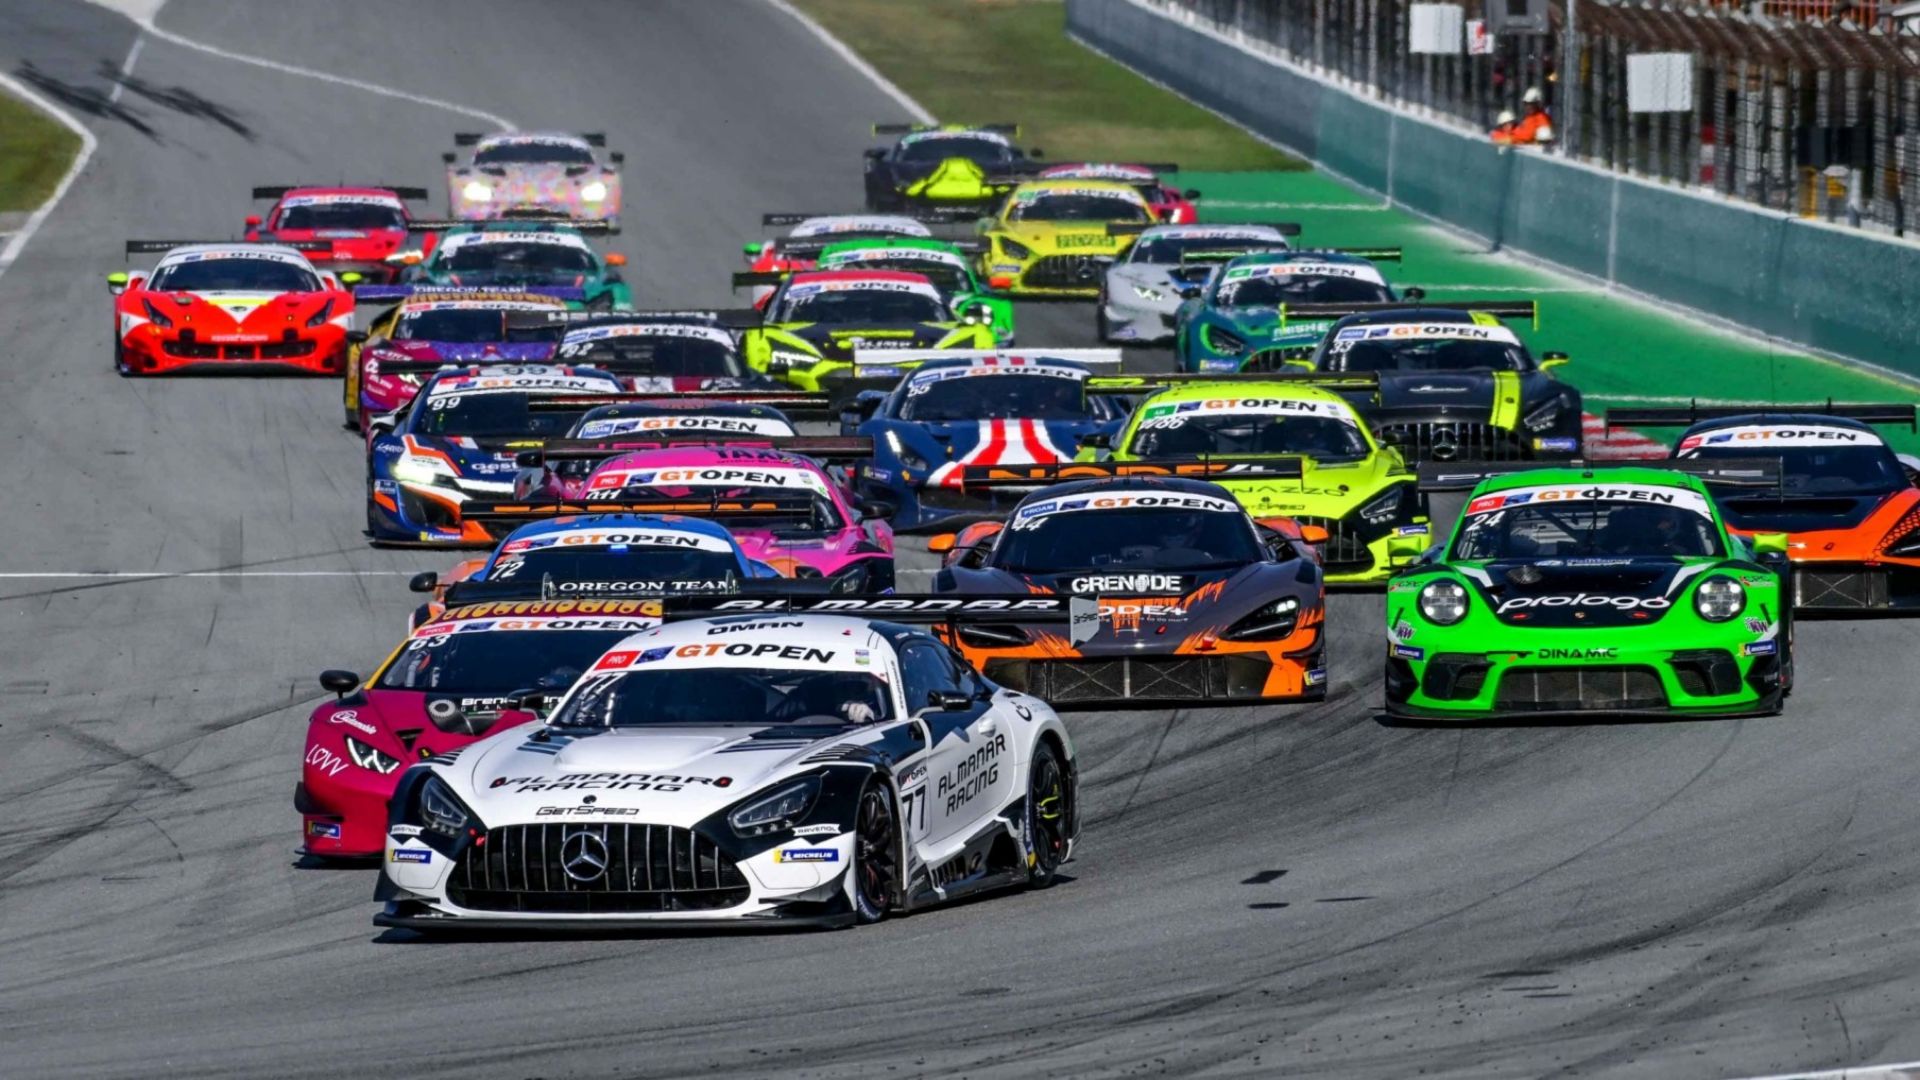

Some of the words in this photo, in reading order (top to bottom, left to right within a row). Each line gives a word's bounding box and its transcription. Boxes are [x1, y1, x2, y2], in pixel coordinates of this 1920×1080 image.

[432, 397, 460, 411] 99
[601, 477, 618, 485] PRO
[1023, 504, 1055, 516] PROAM
[1478, 500, 1495, 508] PRO
[1012, 516, 1049, 532] 44
[1466, 511, 1506, 531] 24
[489, 561, 525, 580] 72
[559, 581, 667, 591] OREGON
[1497, 593, 1672, 614] prologo
[1098, 605, 1187, 617] ODE4
[706, 621, 804, 635] OMAN
[409, 635, 449, 650] 63
[606, 654, 627, 665] PRO
[1538, 648, 1619, 659] DINAMIC
[938, 733, 1006, 799] ALMANAR
[515, 780, 685, 793] RACING
[946, 762, 998, 817] RACING
[901, 784, 926, 831] 77
